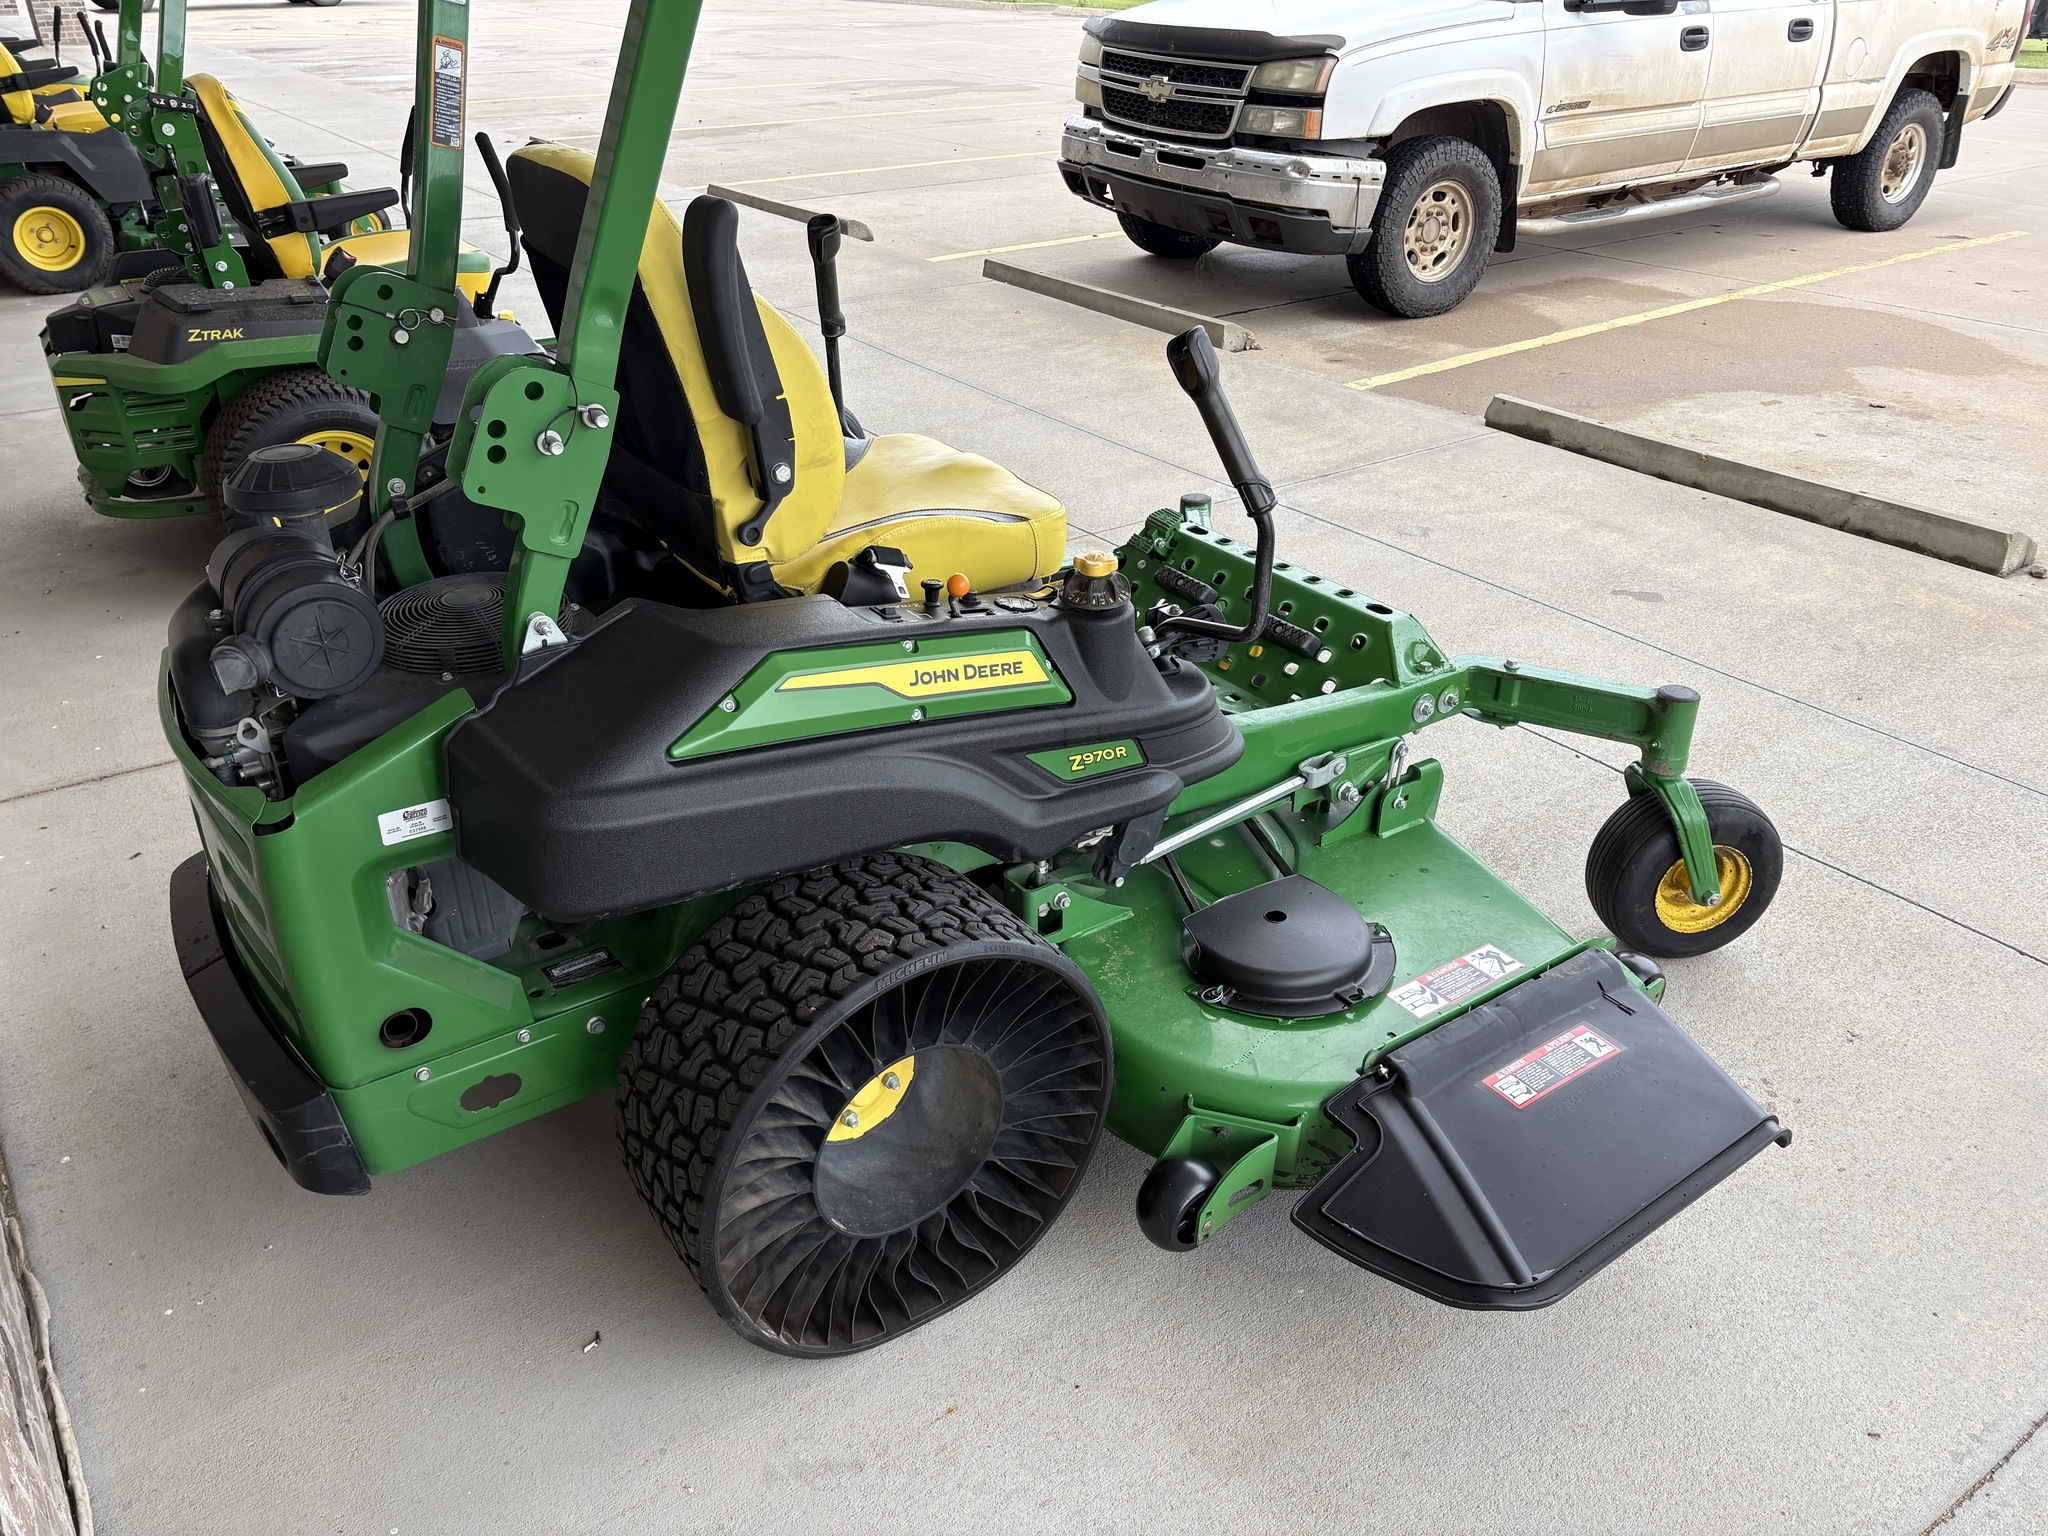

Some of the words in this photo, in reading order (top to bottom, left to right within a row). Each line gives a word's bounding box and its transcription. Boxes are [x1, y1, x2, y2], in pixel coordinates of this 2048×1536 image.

[188, 327, 244, 342] ZTRAK
[909, 668, 960, 687] JOHN
[963, 661, 1024, 680] DEERE
[876, 952, 949, 991] MICHELIN
[1431, 961, 1461, 977] DANGER
[1502, 1059, 1529, 1077] DANGER
[1550, 1032, 1576, 1049] PELIGRO
